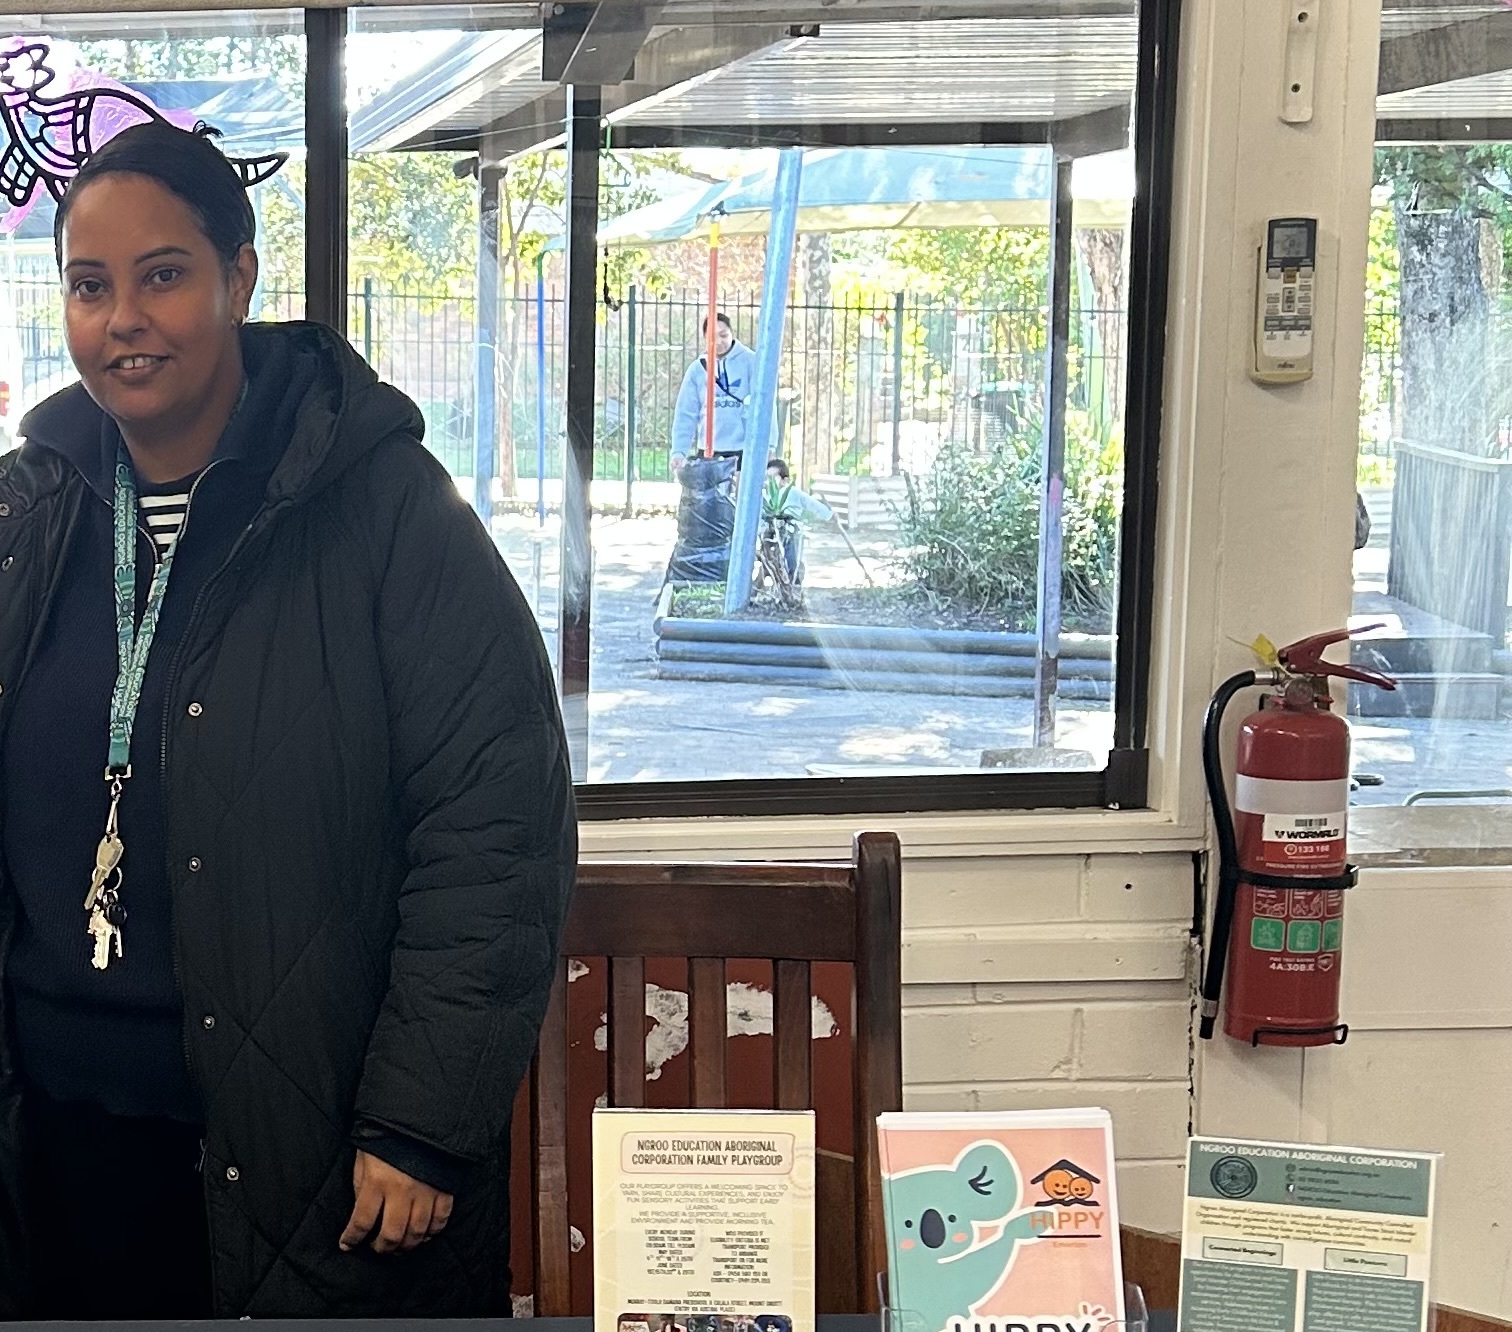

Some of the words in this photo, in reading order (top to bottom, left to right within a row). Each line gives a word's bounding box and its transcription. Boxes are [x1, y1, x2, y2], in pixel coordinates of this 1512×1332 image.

[1298, 845, 1314, 853] 133
[637, 1139, 670, 1151] NGROO
[672, 1140, 722, 1152] EDUCATION
[724, 1140, 778, 1152] ABORIGINAL
[631, 1154, 694, 1165] CORPORATION
[696, 1154, 728, 1166] FAMILY
[731, 1155, 783, 1166] PLAYGROUP
[1200, 1143, 1236, 1155] NGROO
[1237, 1146, 1290, 1159] EDUCATION
[1291, 1151, 1348, 1165] ABORIGINAL
[1349, 1155, 1418, 1170] CORPORATION
[1030, 1211, 1105, 1230] HIPPY
